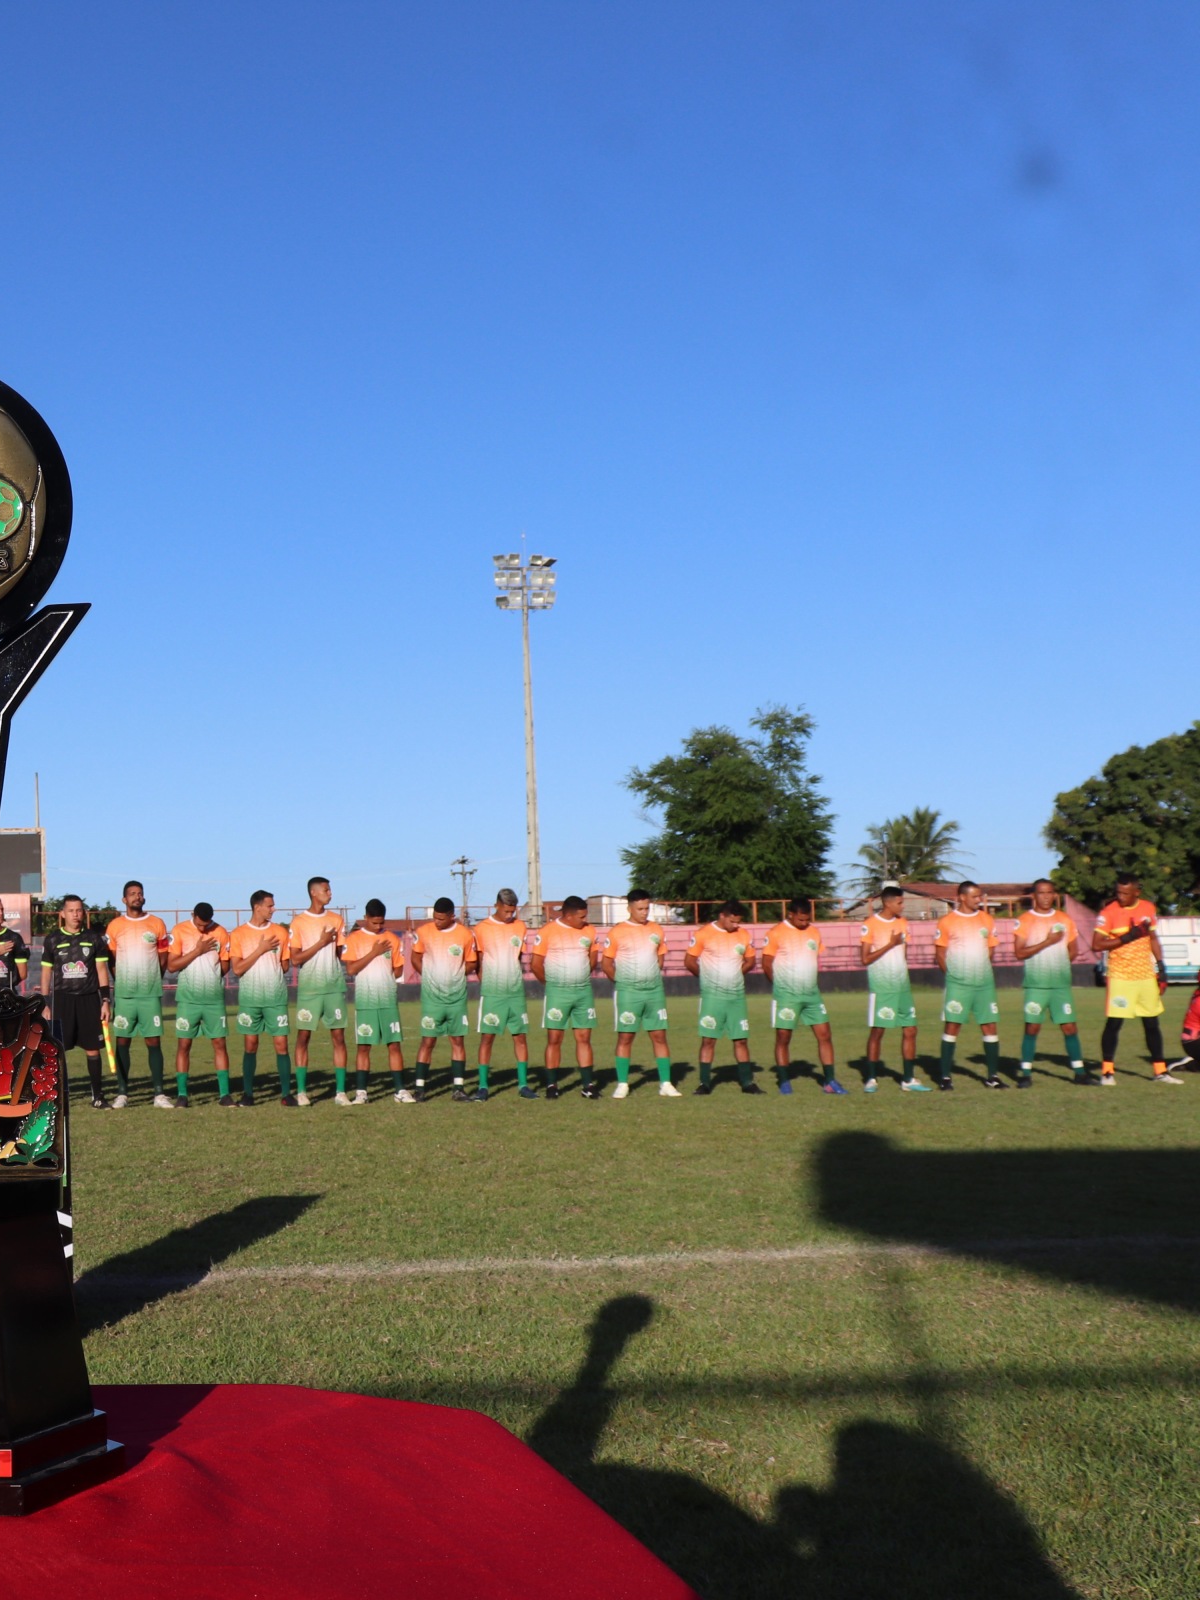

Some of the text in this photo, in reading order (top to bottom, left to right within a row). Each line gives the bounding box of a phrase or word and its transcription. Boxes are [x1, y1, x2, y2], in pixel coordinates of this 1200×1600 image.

[335, 1008, 342, 1020] 8
[820, 1004, 827, 1014] 3
[990, 1003, 998, 1014] 5
[1063, 1003, 1072, 1014] 6
[153, 1016, 160, 1027] 9
[277, 1015, 288, 1027] 22
[462, 1015, 468, 1026] 4
[390, 1022, 400, 1033] 14
